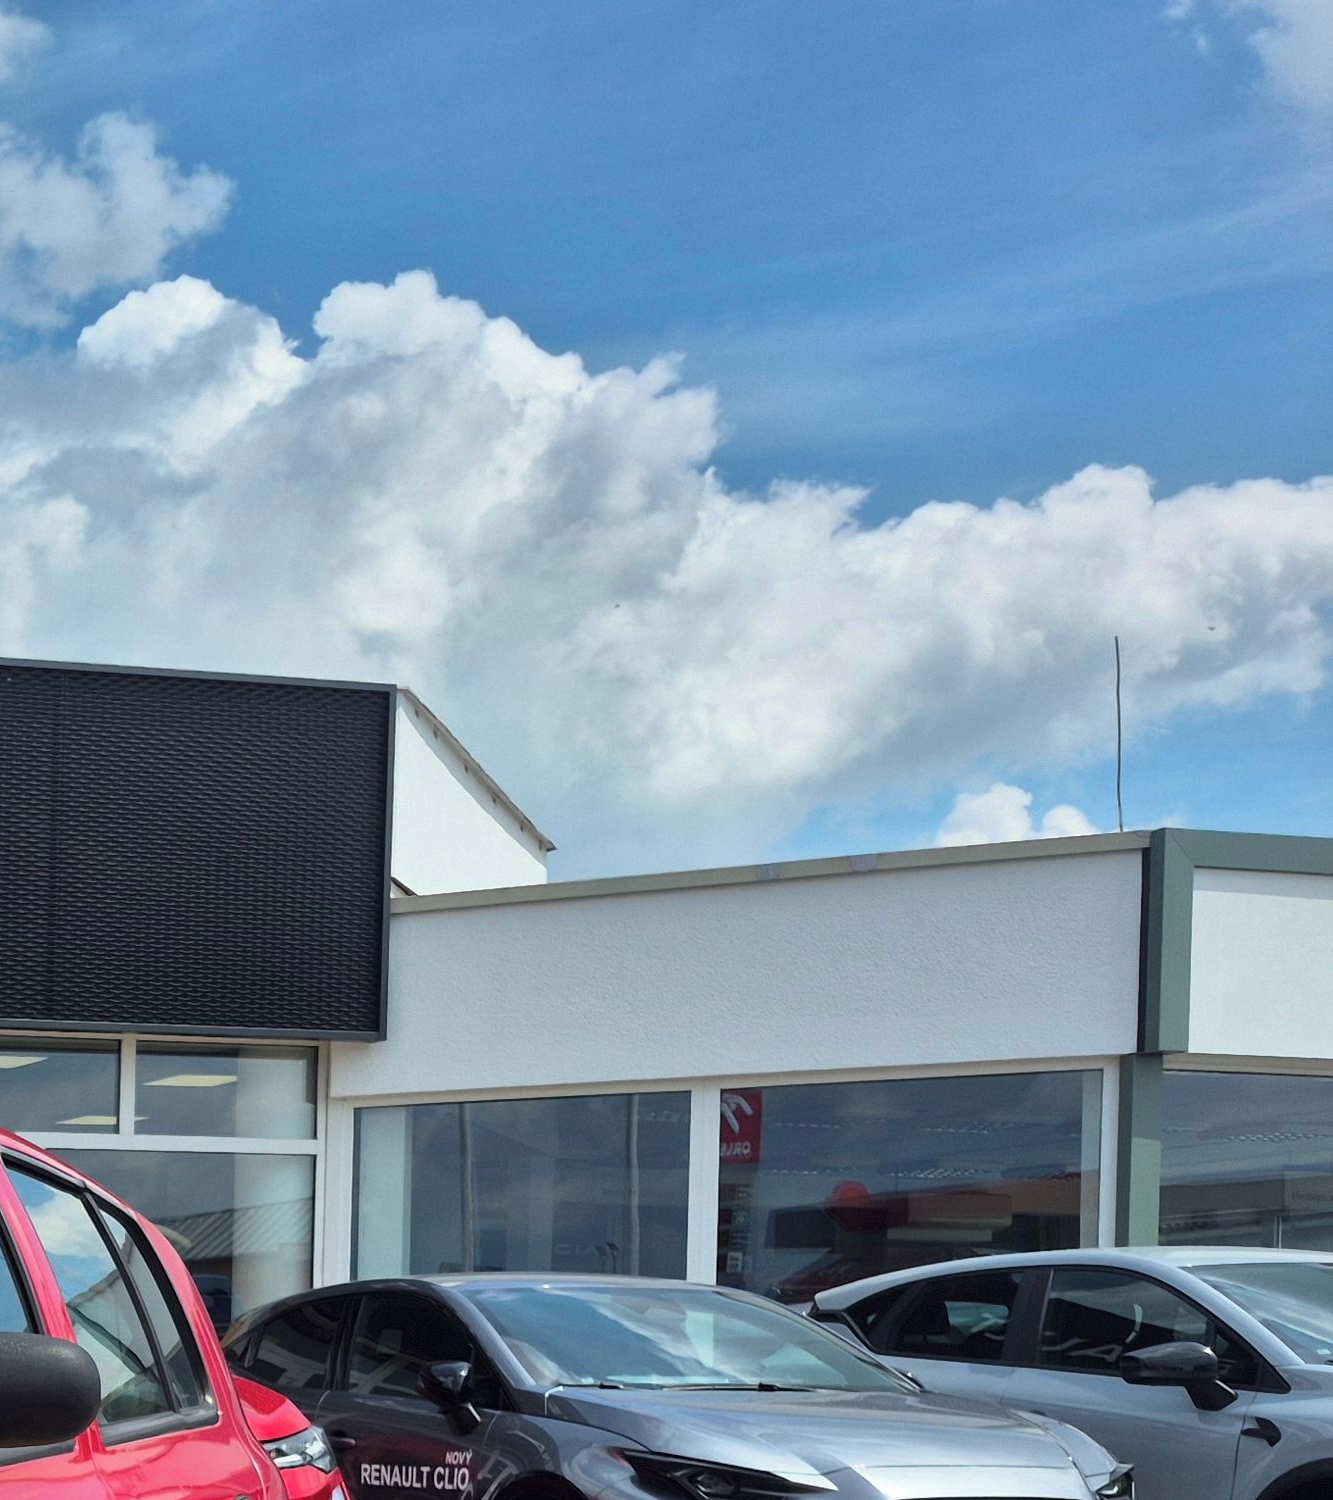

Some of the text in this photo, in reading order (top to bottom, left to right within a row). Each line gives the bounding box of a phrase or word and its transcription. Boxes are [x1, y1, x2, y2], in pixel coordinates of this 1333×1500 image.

[445, 1448, 473, 1465] NOVÝ
[360, 1463, 470, 1491] RENAULT CLIO
